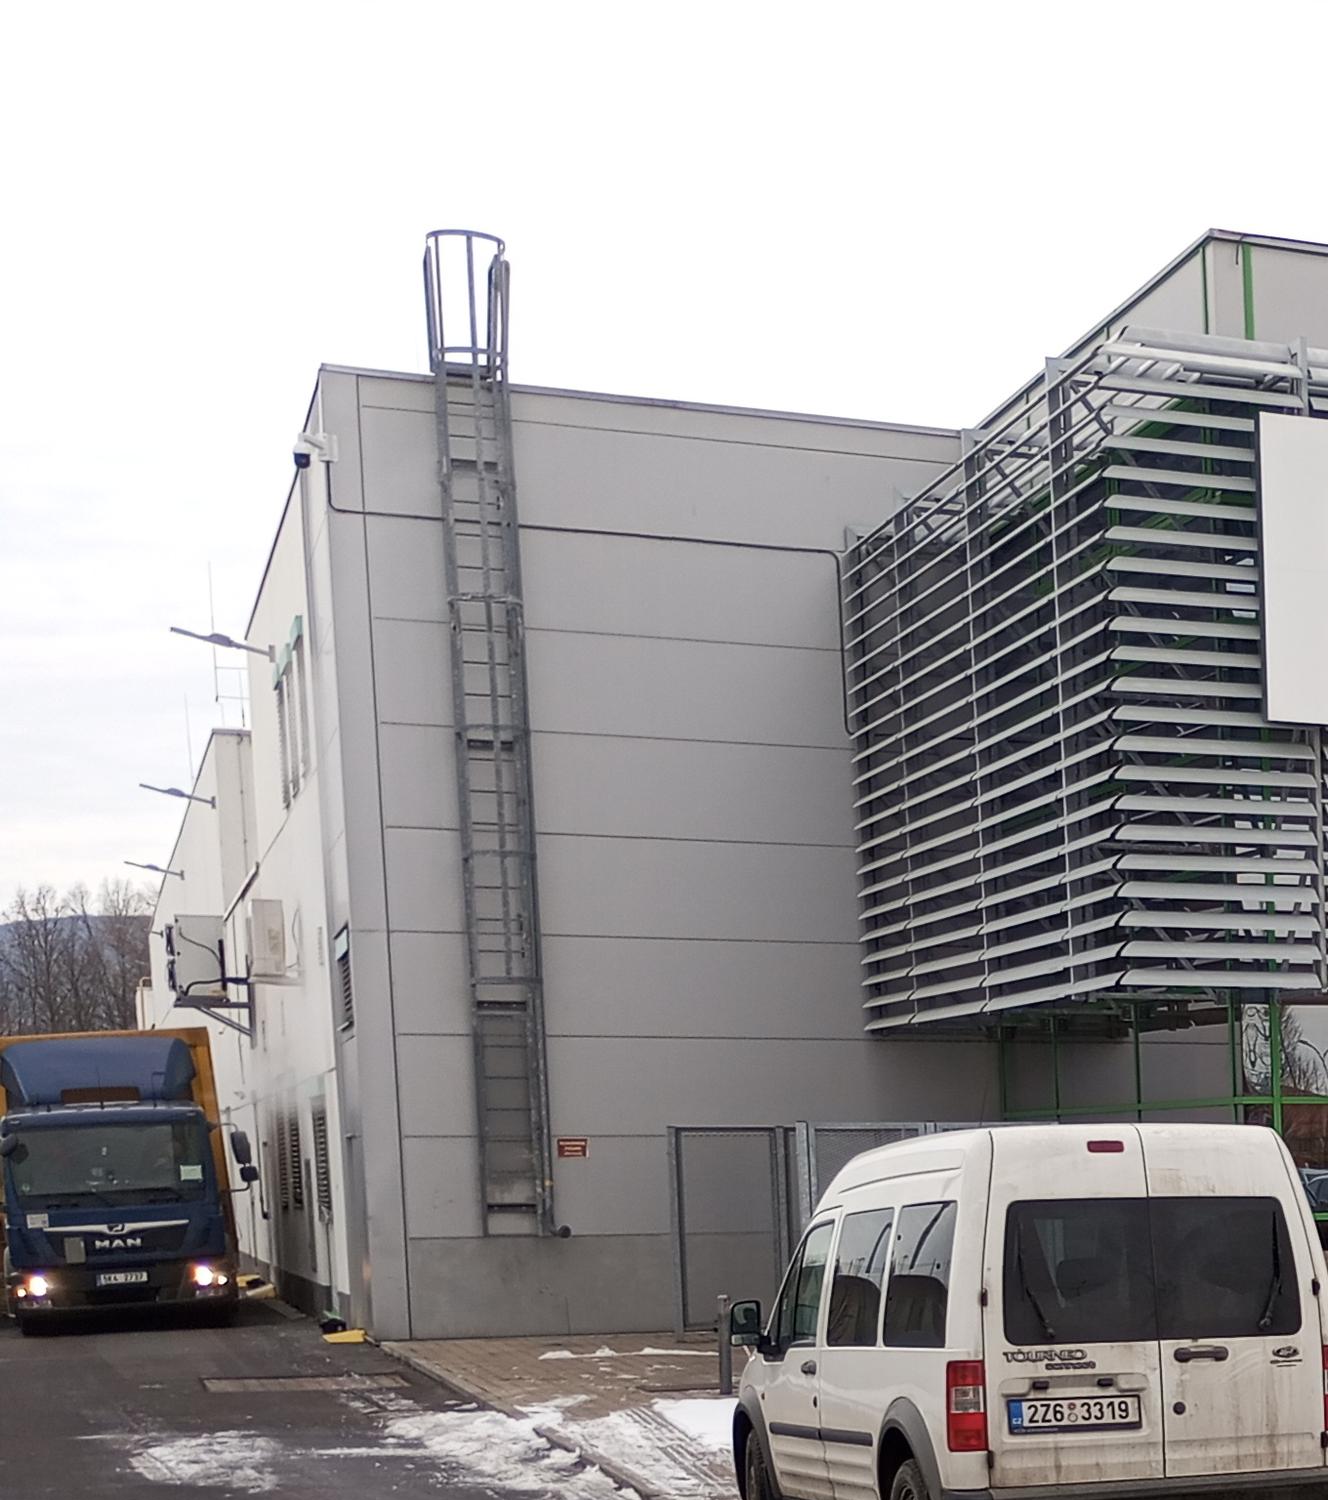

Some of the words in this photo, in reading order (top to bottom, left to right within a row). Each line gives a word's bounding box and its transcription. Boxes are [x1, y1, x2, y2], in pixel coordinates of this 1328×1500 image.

[94, 1237, 142, 1249] MAN
[1003, 1349, 1088, 1363] TOURNEO
[1027, 1402, 1065, 1424] 2Z6
[1080, 1400, 1130, 1421] 3319
